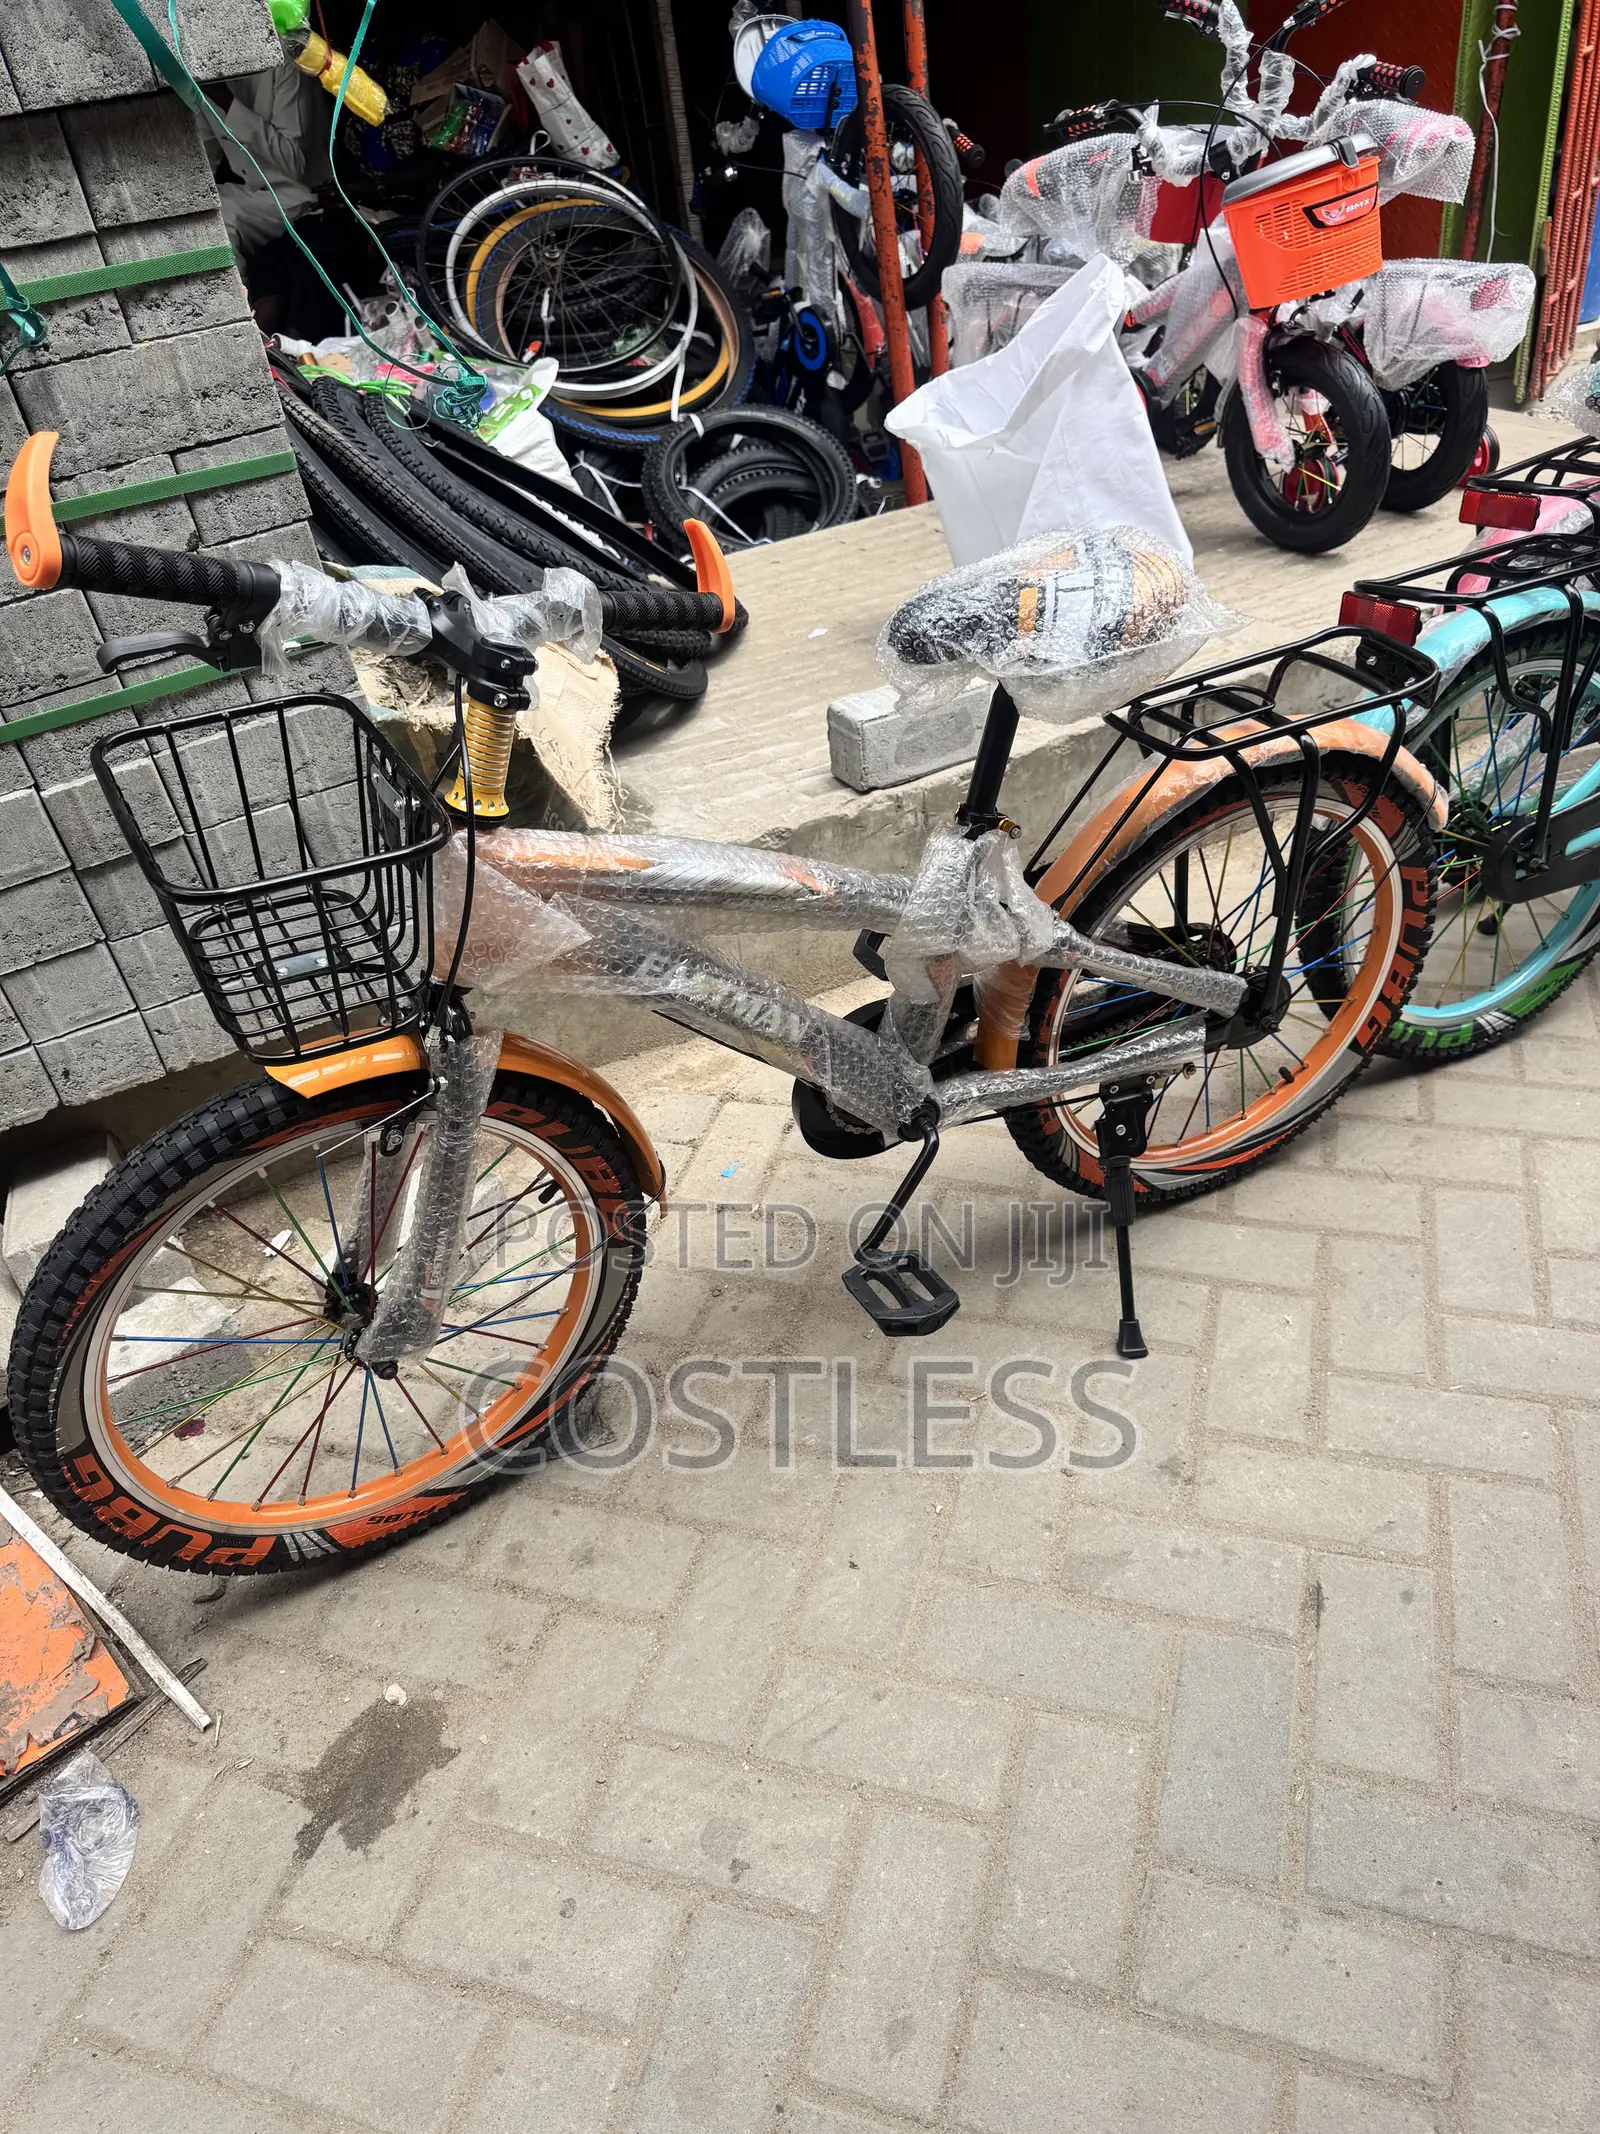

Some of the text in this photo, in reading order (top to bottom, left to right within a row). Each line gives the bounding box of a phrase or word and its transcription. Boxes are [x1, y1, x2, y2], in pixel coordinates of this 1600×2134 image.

[1354, 865, 1429, 1051] PUBG
[62, 1453, 277, 1567] PUBG
[366, 1505, 438, 1525] PUBG
